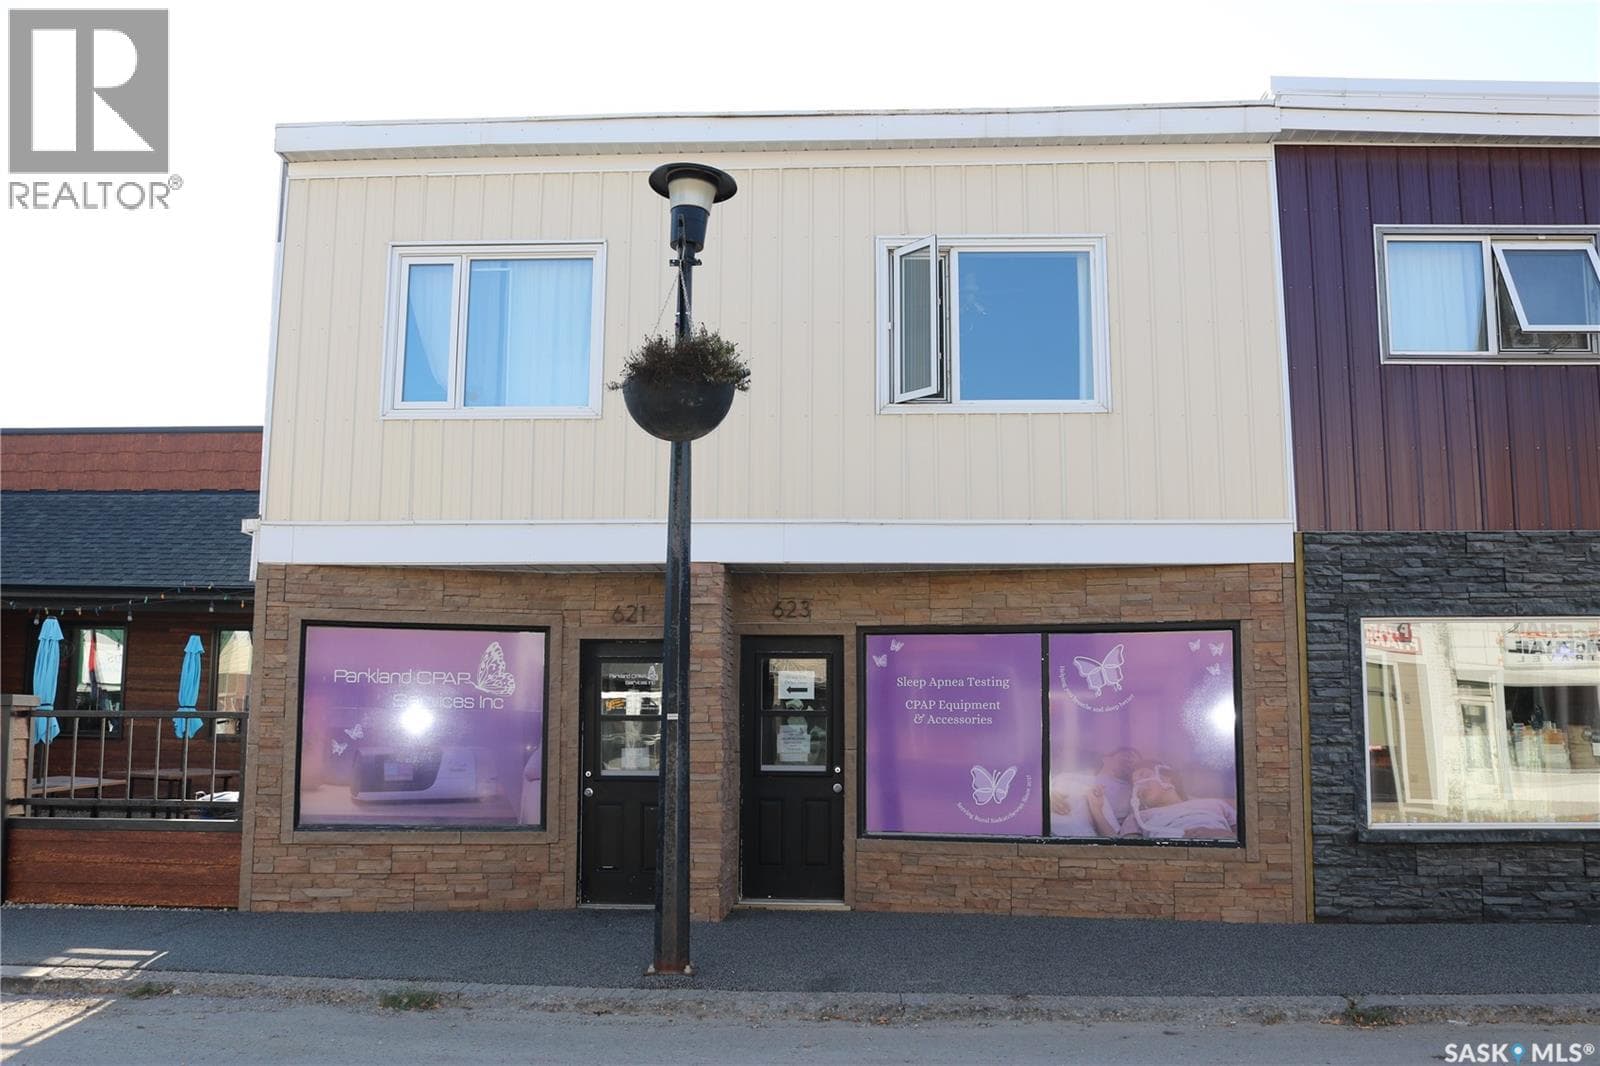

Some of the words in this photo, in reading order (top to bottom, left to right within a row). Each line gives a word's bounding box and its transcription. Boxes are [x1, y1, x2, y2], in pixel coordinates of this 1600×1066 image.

[612, 604, 646, 624] 621
[771, 599, 811, 619] 623
[333, 667, 413, 685] Parkland
[416, 671, 472, 686] CPAP
[896, 676, 927, 690] Sleep
[928, 676, 965, 689] Apnea
[966, 676, 1010, 690] Testing
[479, 694, 504, 710] Inc
[905, 700, 936, 710] CPAP
[939, 700, 1001, 712] Equipment
[913, 713, 925, 725] &
[927, 713, 993, 725] Accessories
